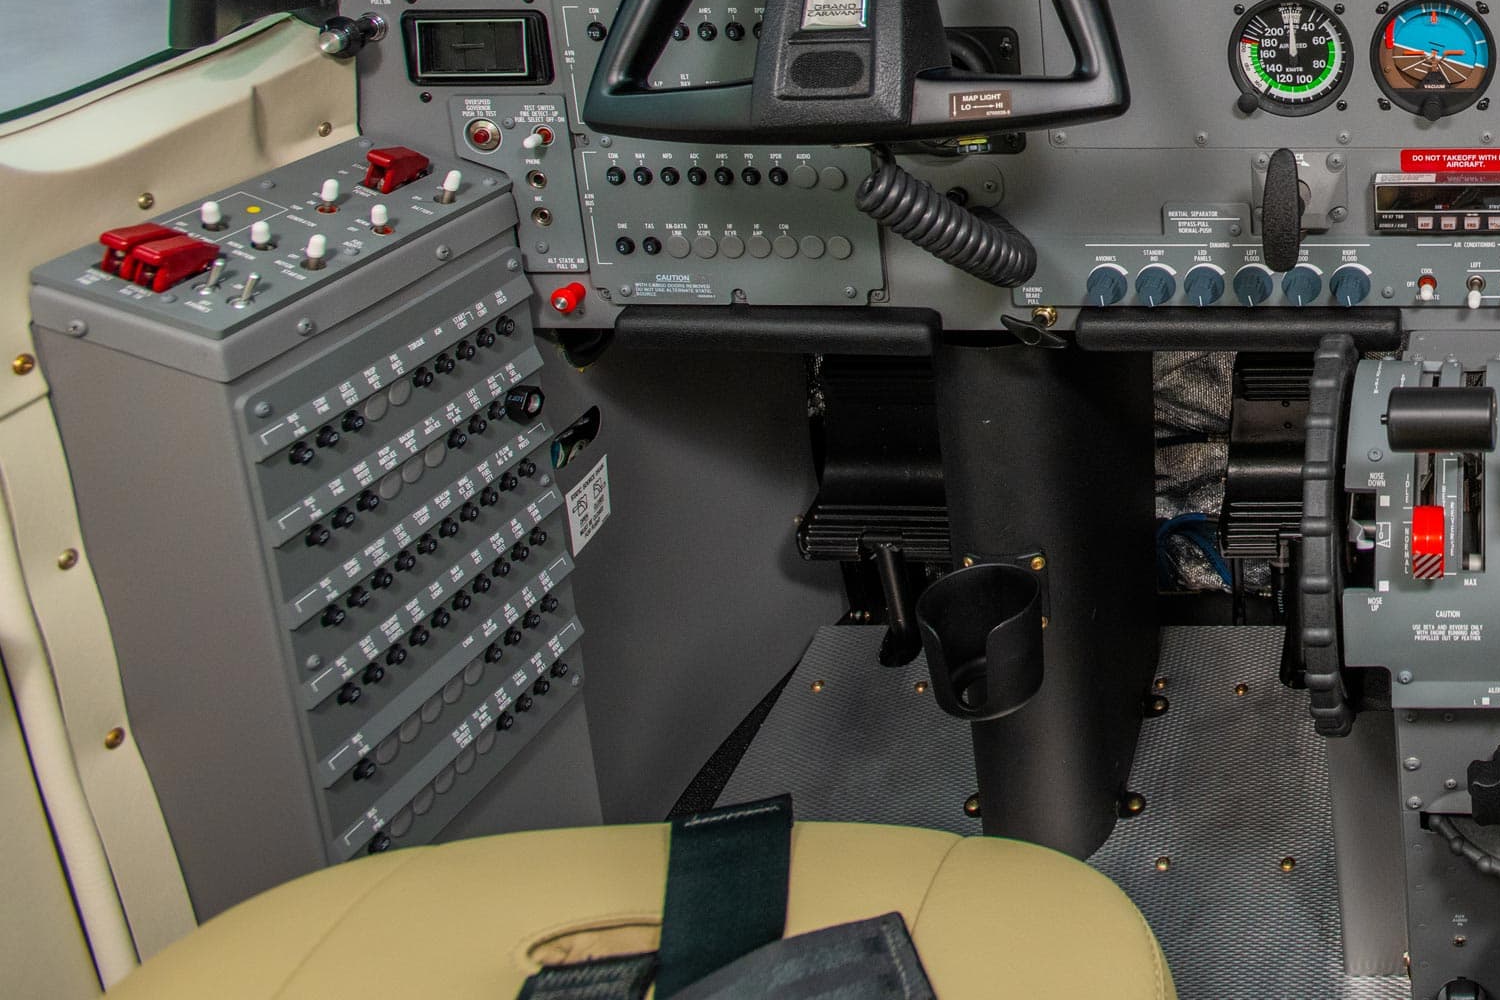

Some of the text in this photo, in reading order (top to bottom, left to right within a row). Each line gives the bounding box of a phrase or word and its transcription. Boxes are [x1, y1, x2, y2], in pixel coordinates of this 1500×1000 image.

[1301, 23, 1314, 31] 40
[1265, 28, 1283, 36] 200
[1261, 39, 1277, 47] 180
[1260, 50, 1276, 58] 160
[1266, 64, 1282, 72] 140
[1313, 60, 1326, 68] 80
[1277, 74, 1292, 82] 120
[1296, 75, 1312, 83] 100
[1436, 610, 1460, 618] CAUTION
